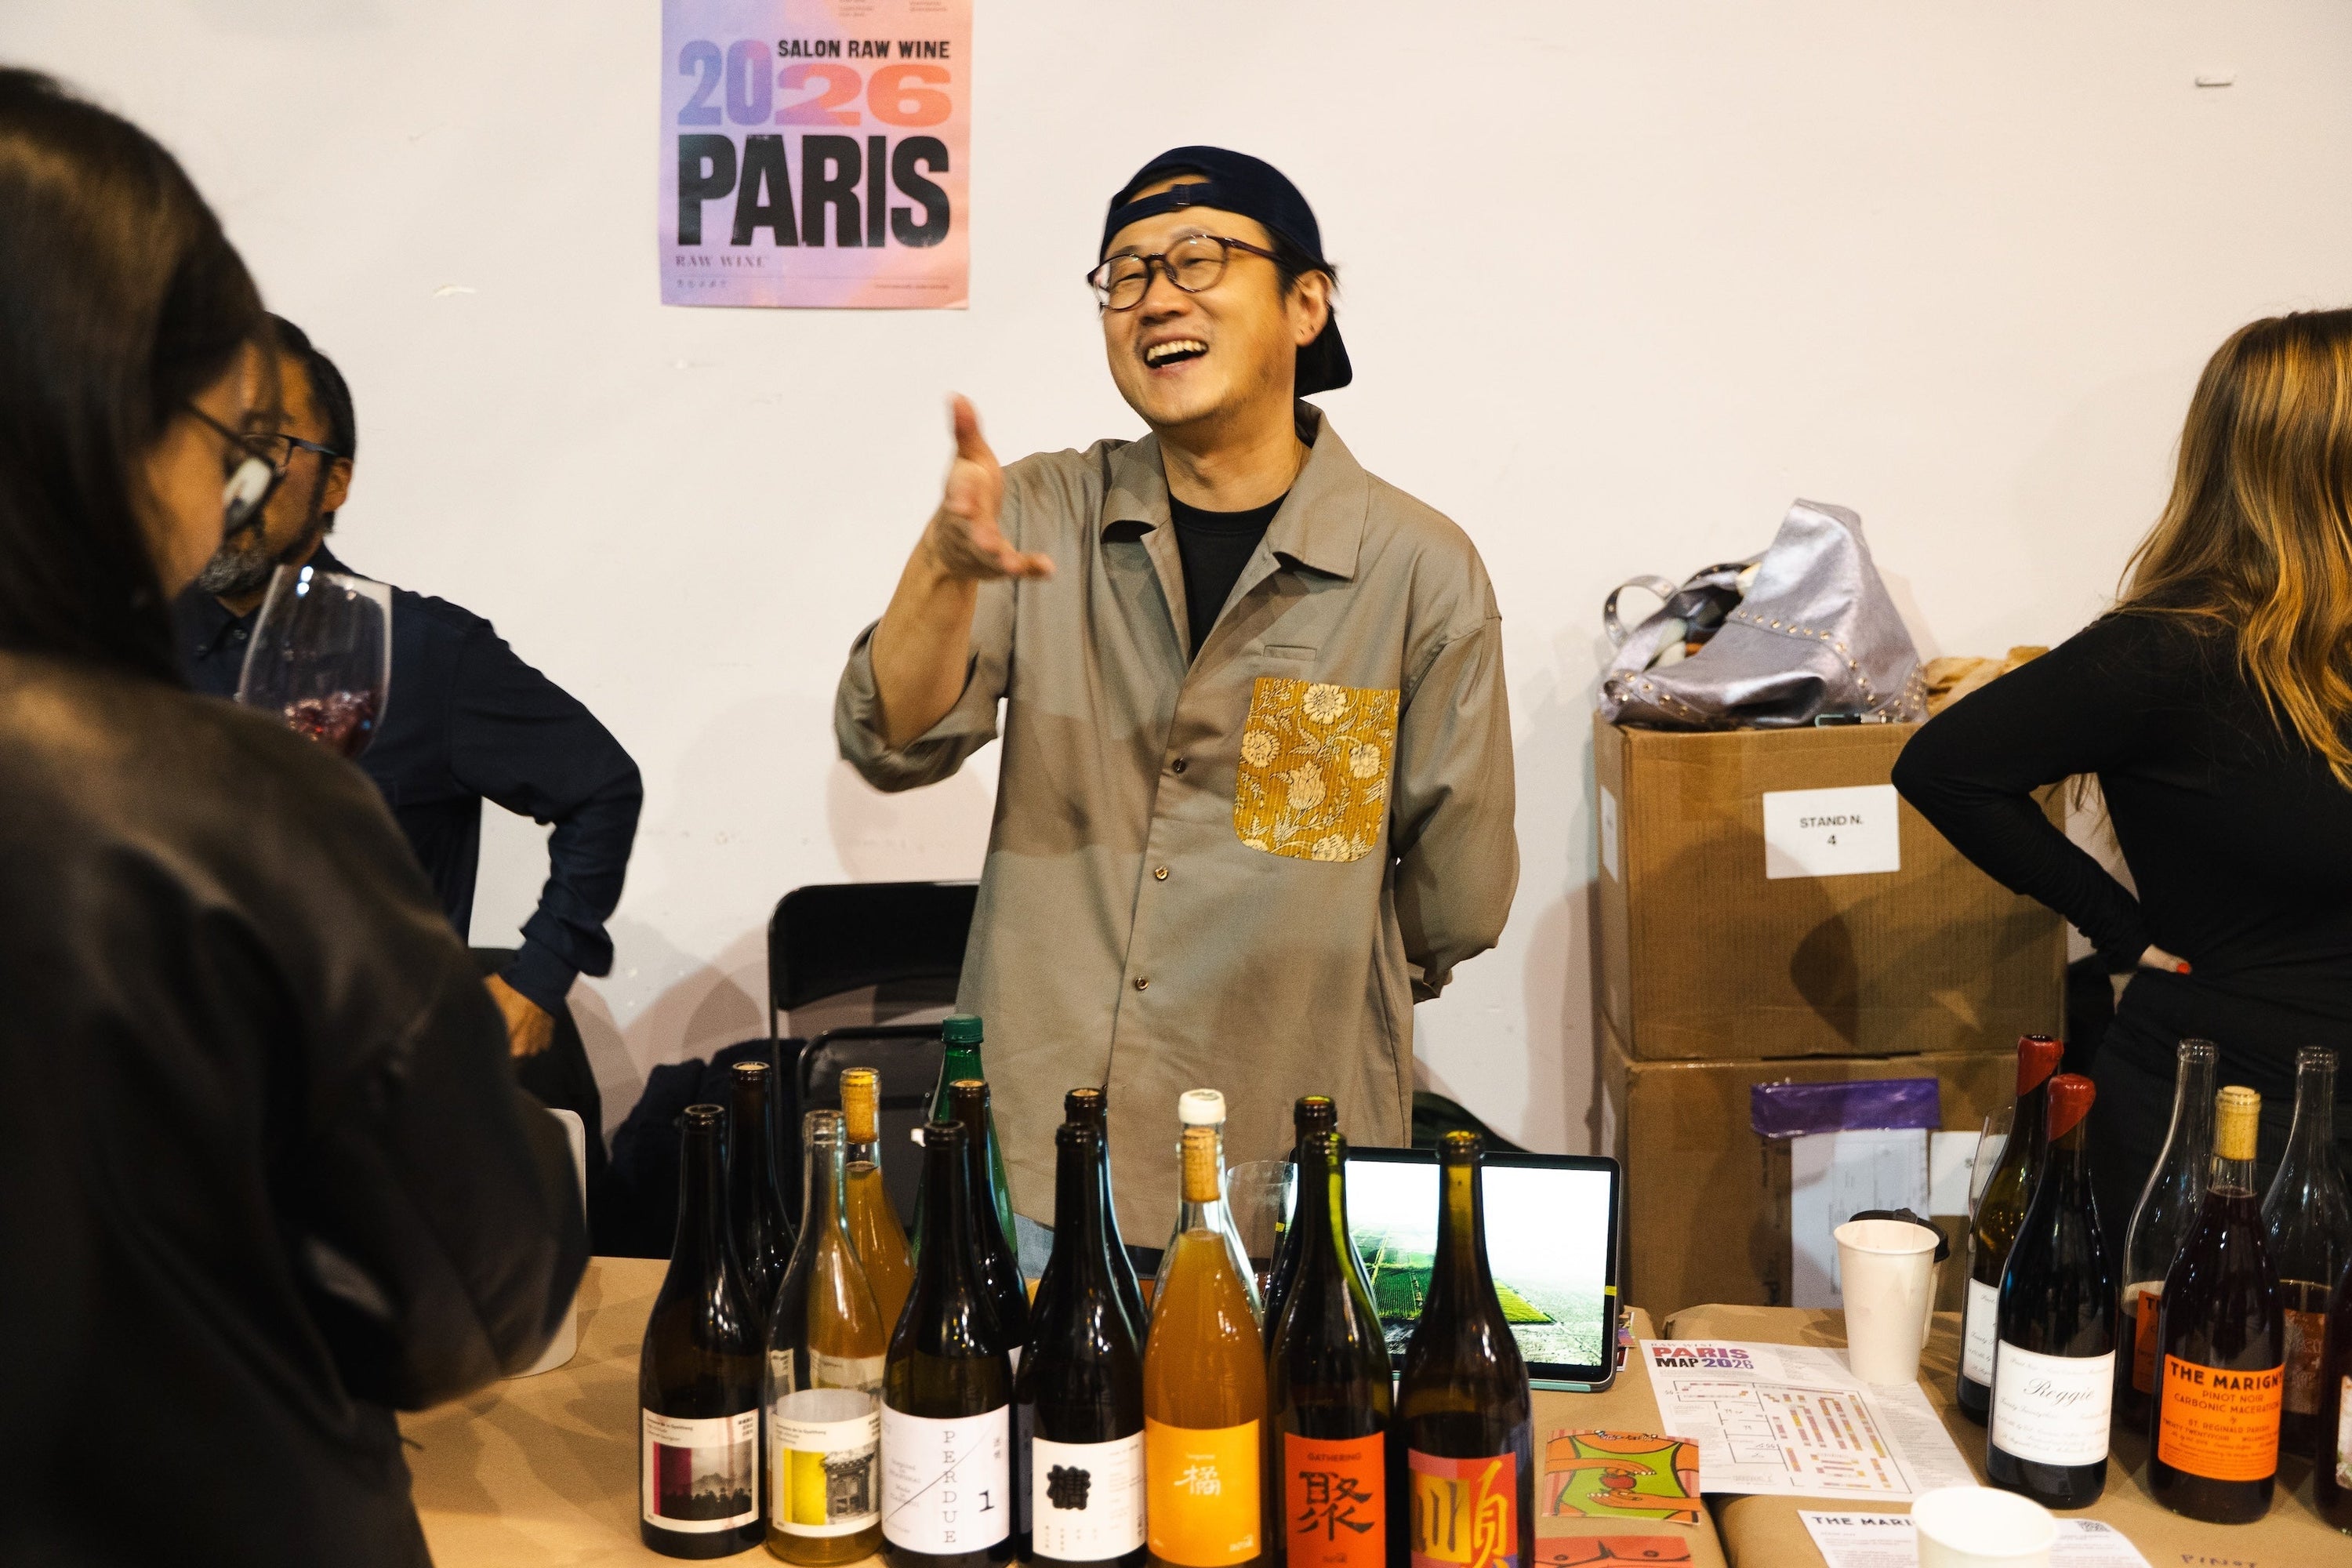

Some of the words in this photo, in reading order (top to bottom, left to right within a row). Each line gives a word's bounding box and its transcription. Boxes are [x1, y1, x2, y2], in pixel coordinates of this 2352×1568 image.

[778, 39, 840, 58] SALON
[848, 40, 890, 58] RAW
[898, 41, 950, 59] WINE
[677, 39, 953, 127] 2026
[678, 134, 950, 248] PARIS
[675, 255, 711, 267] RAW
[720, 255, 766, 268] WINE
[1800, 815, 1846, 829] STAND
[1850, 815, 1863, 825] N.
[1827, 835, 1837, 845] 4
[1653, 1348, 1749, 1359] PARIS
[1656, 1358, 1699, 1367] MAP
[1701, 1358, 1754, 1370] 2026
[2170, 1362, 2205, 1385] THE
[2024, 1377, 2095, 1406] Reggie
[2202, 1390, 2235, 1402] PINOT
[2174, 1393, 2226, 1412] CARBONIC
[2230, 1401, 2279, 1414] MACERATION
[2203, 1422, 2243, 1433] REGINALD
[1307, 1452, 1361, 1462] GATHERING
[942, 1430, 957, 1543] PERDUE
[978, 1490, 994, 1512] 1
[1297, 1471, 1375, 1541] 聚
[1812, 1516, 1854, 1526] THE
[1861, 1518, 1914, 1526] MARI
